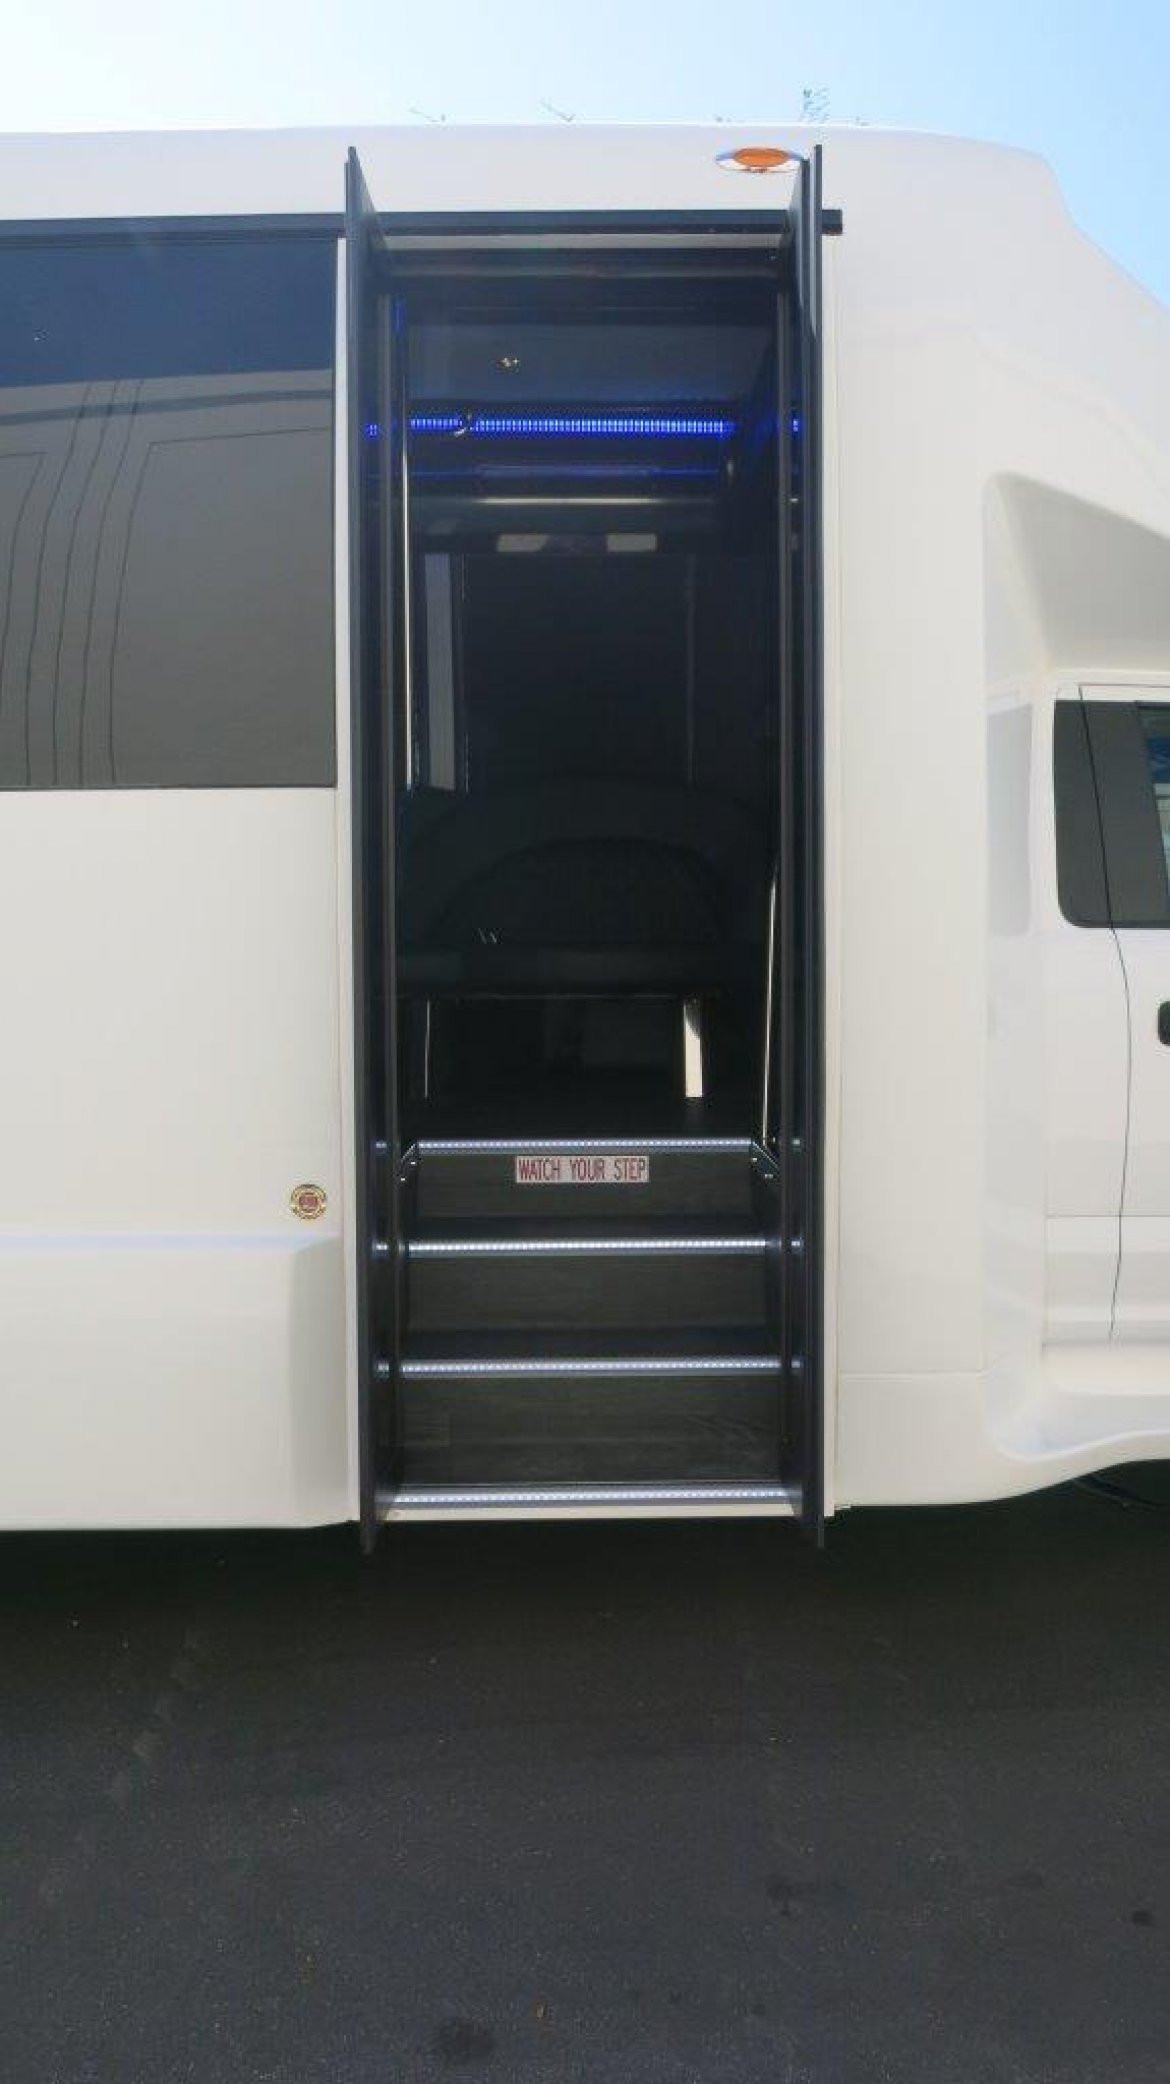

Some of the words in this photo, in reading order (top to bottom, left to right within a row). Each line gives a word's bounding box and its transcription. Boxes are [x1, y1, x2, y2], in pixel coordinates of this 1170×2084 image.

[518, 1158, 560, 1181] WATCH
[569, 1158, 605, 1181] YOUR
[614, 1158, 646, 1181] STEP
